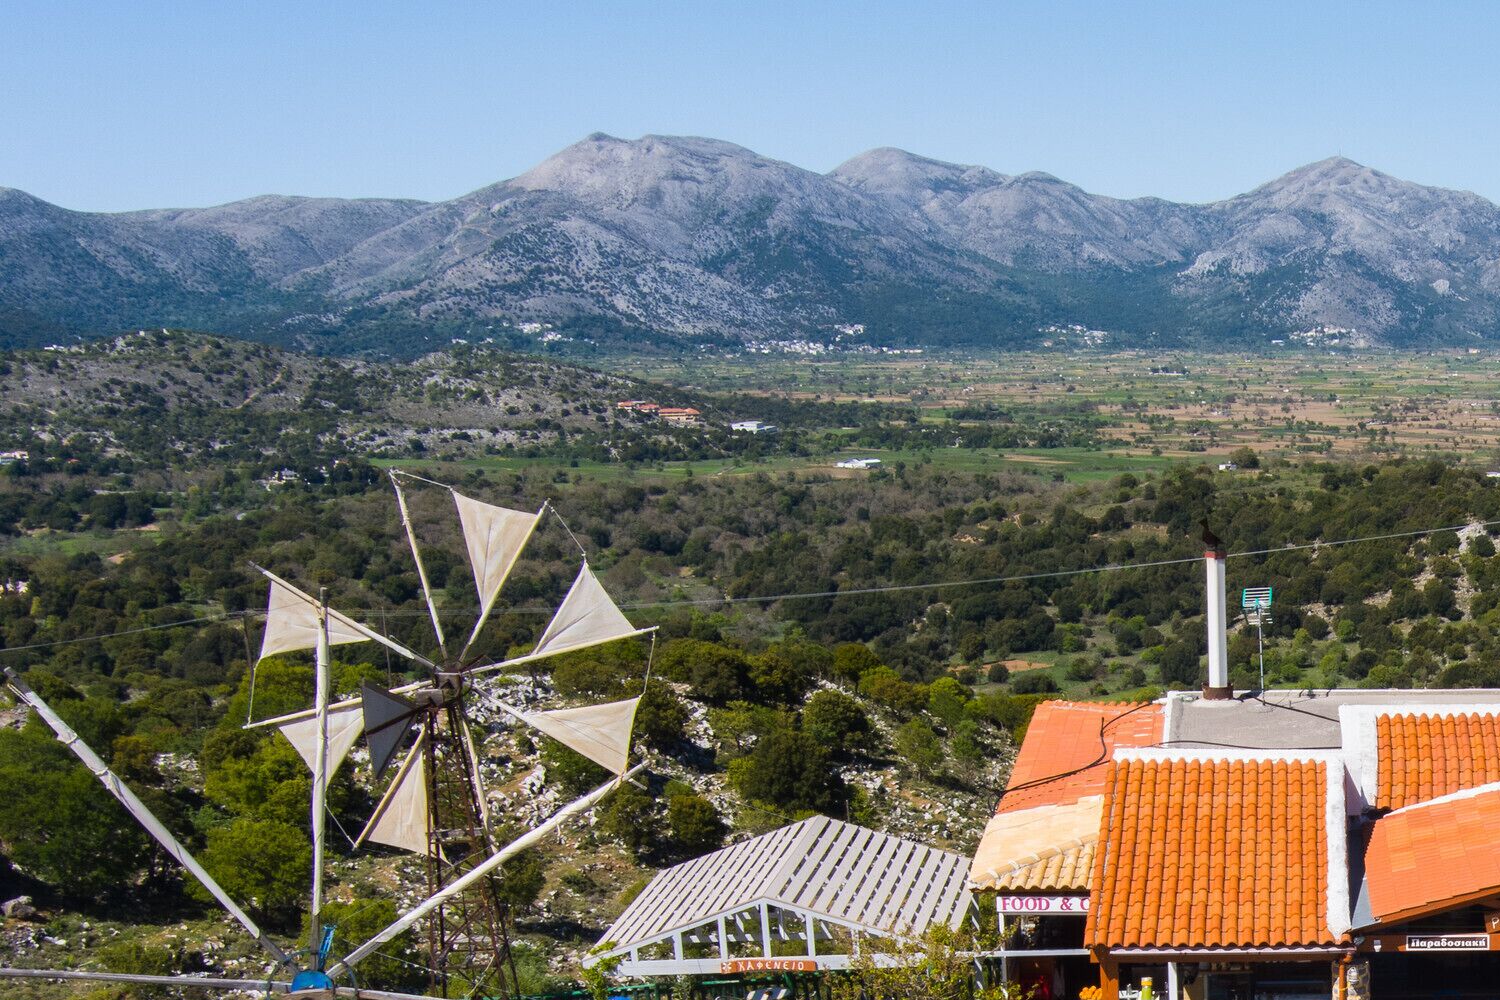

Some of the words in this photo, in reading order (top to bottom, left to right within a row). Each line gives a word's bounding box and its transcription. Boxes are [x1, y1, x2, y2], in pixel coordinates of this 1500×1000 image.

[1001, 897, 1051, 911] FOOD
[1060, 897, 1073, 911] &
[1411, 938, 1486, 949] Παραδοσιακή
